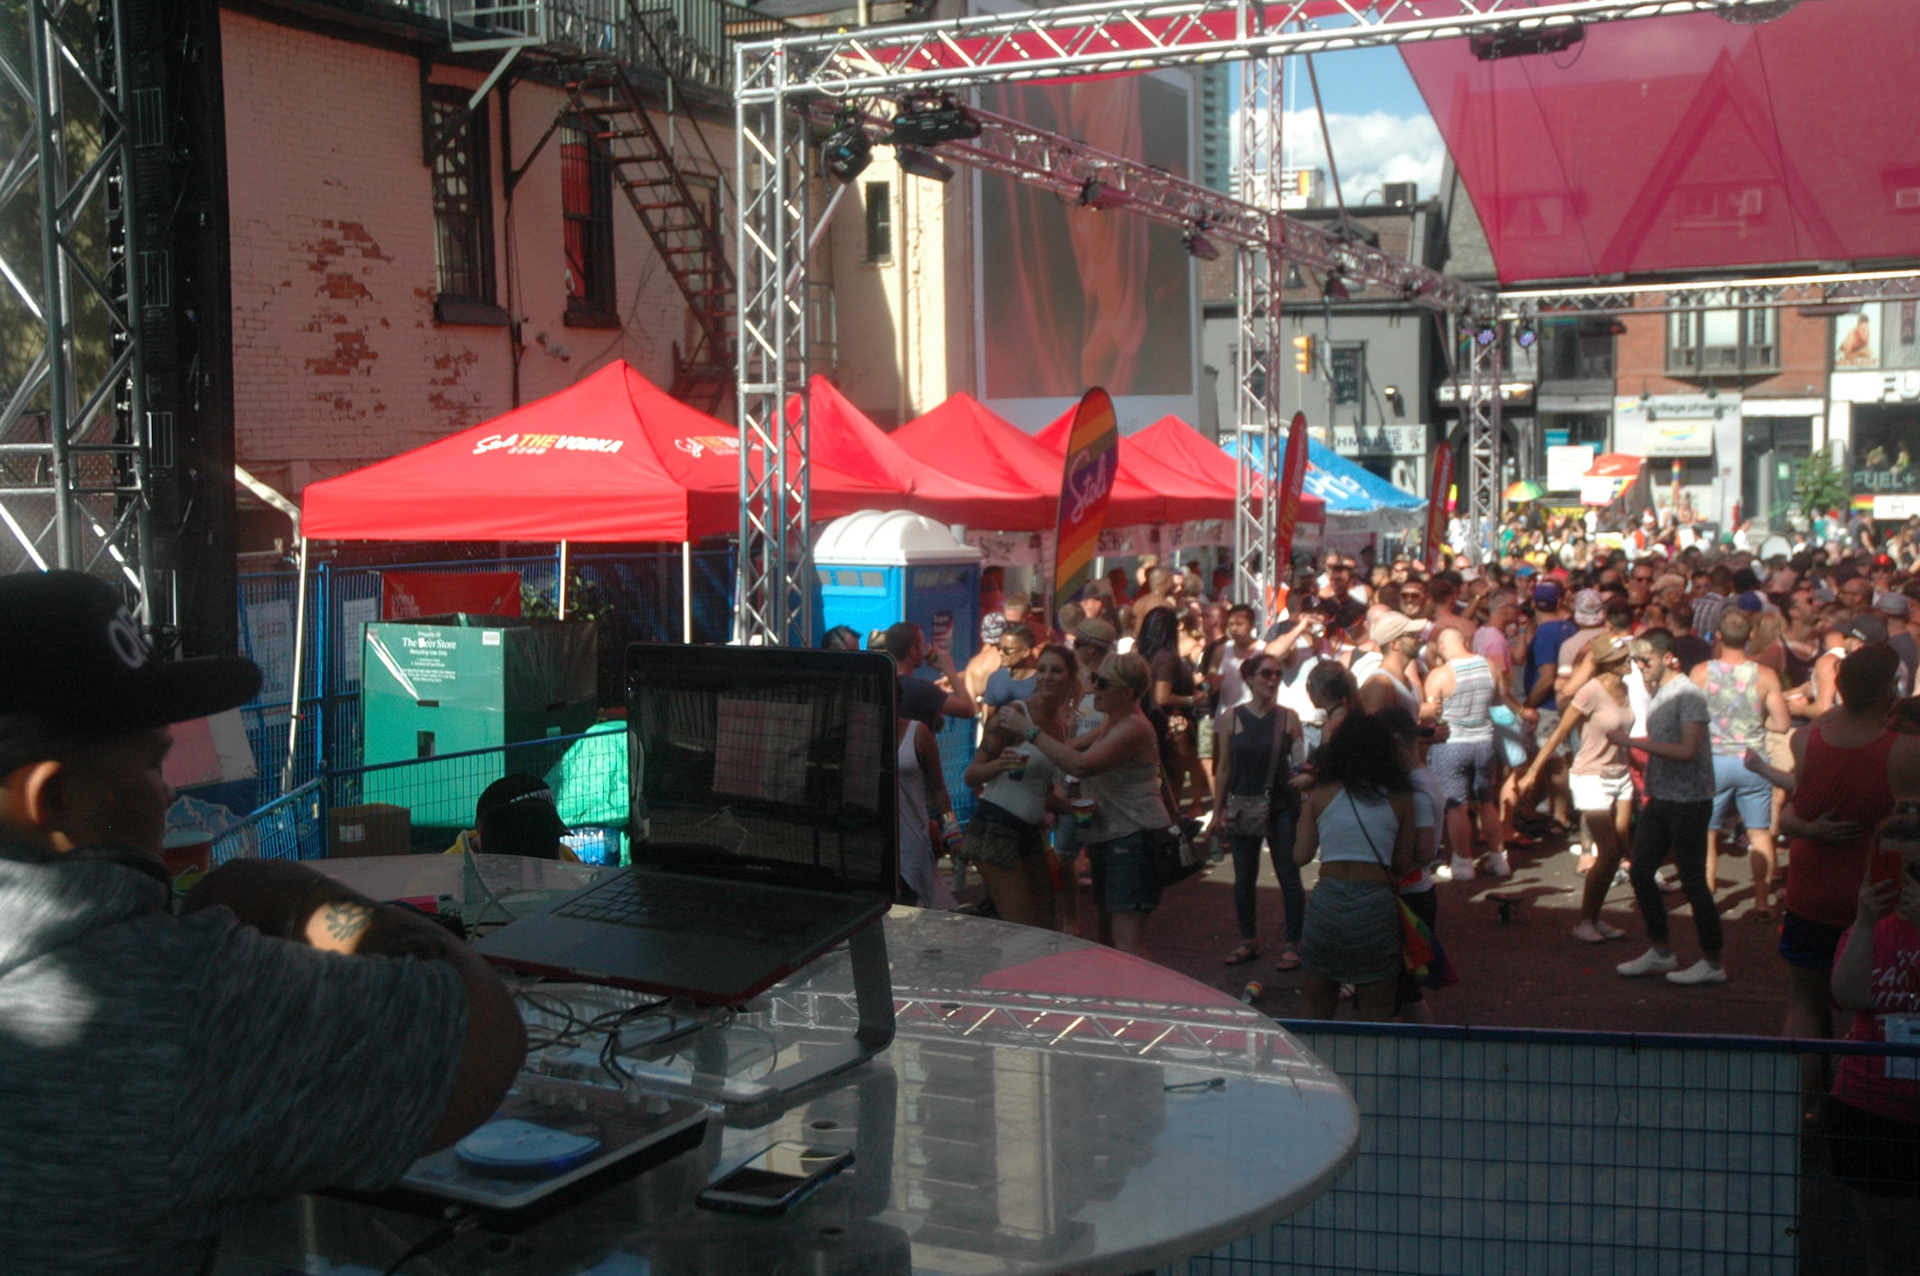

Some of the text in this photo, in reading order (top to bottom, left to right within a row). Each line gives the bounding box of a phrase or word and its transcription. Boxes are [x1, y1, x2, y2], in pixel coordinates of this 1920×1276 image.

[518, 434, 559, 448] THE
[555, 435, 624, 454] VODKA
[402, 636, 418, 648] The
[436, 638, 457, 650] Store
